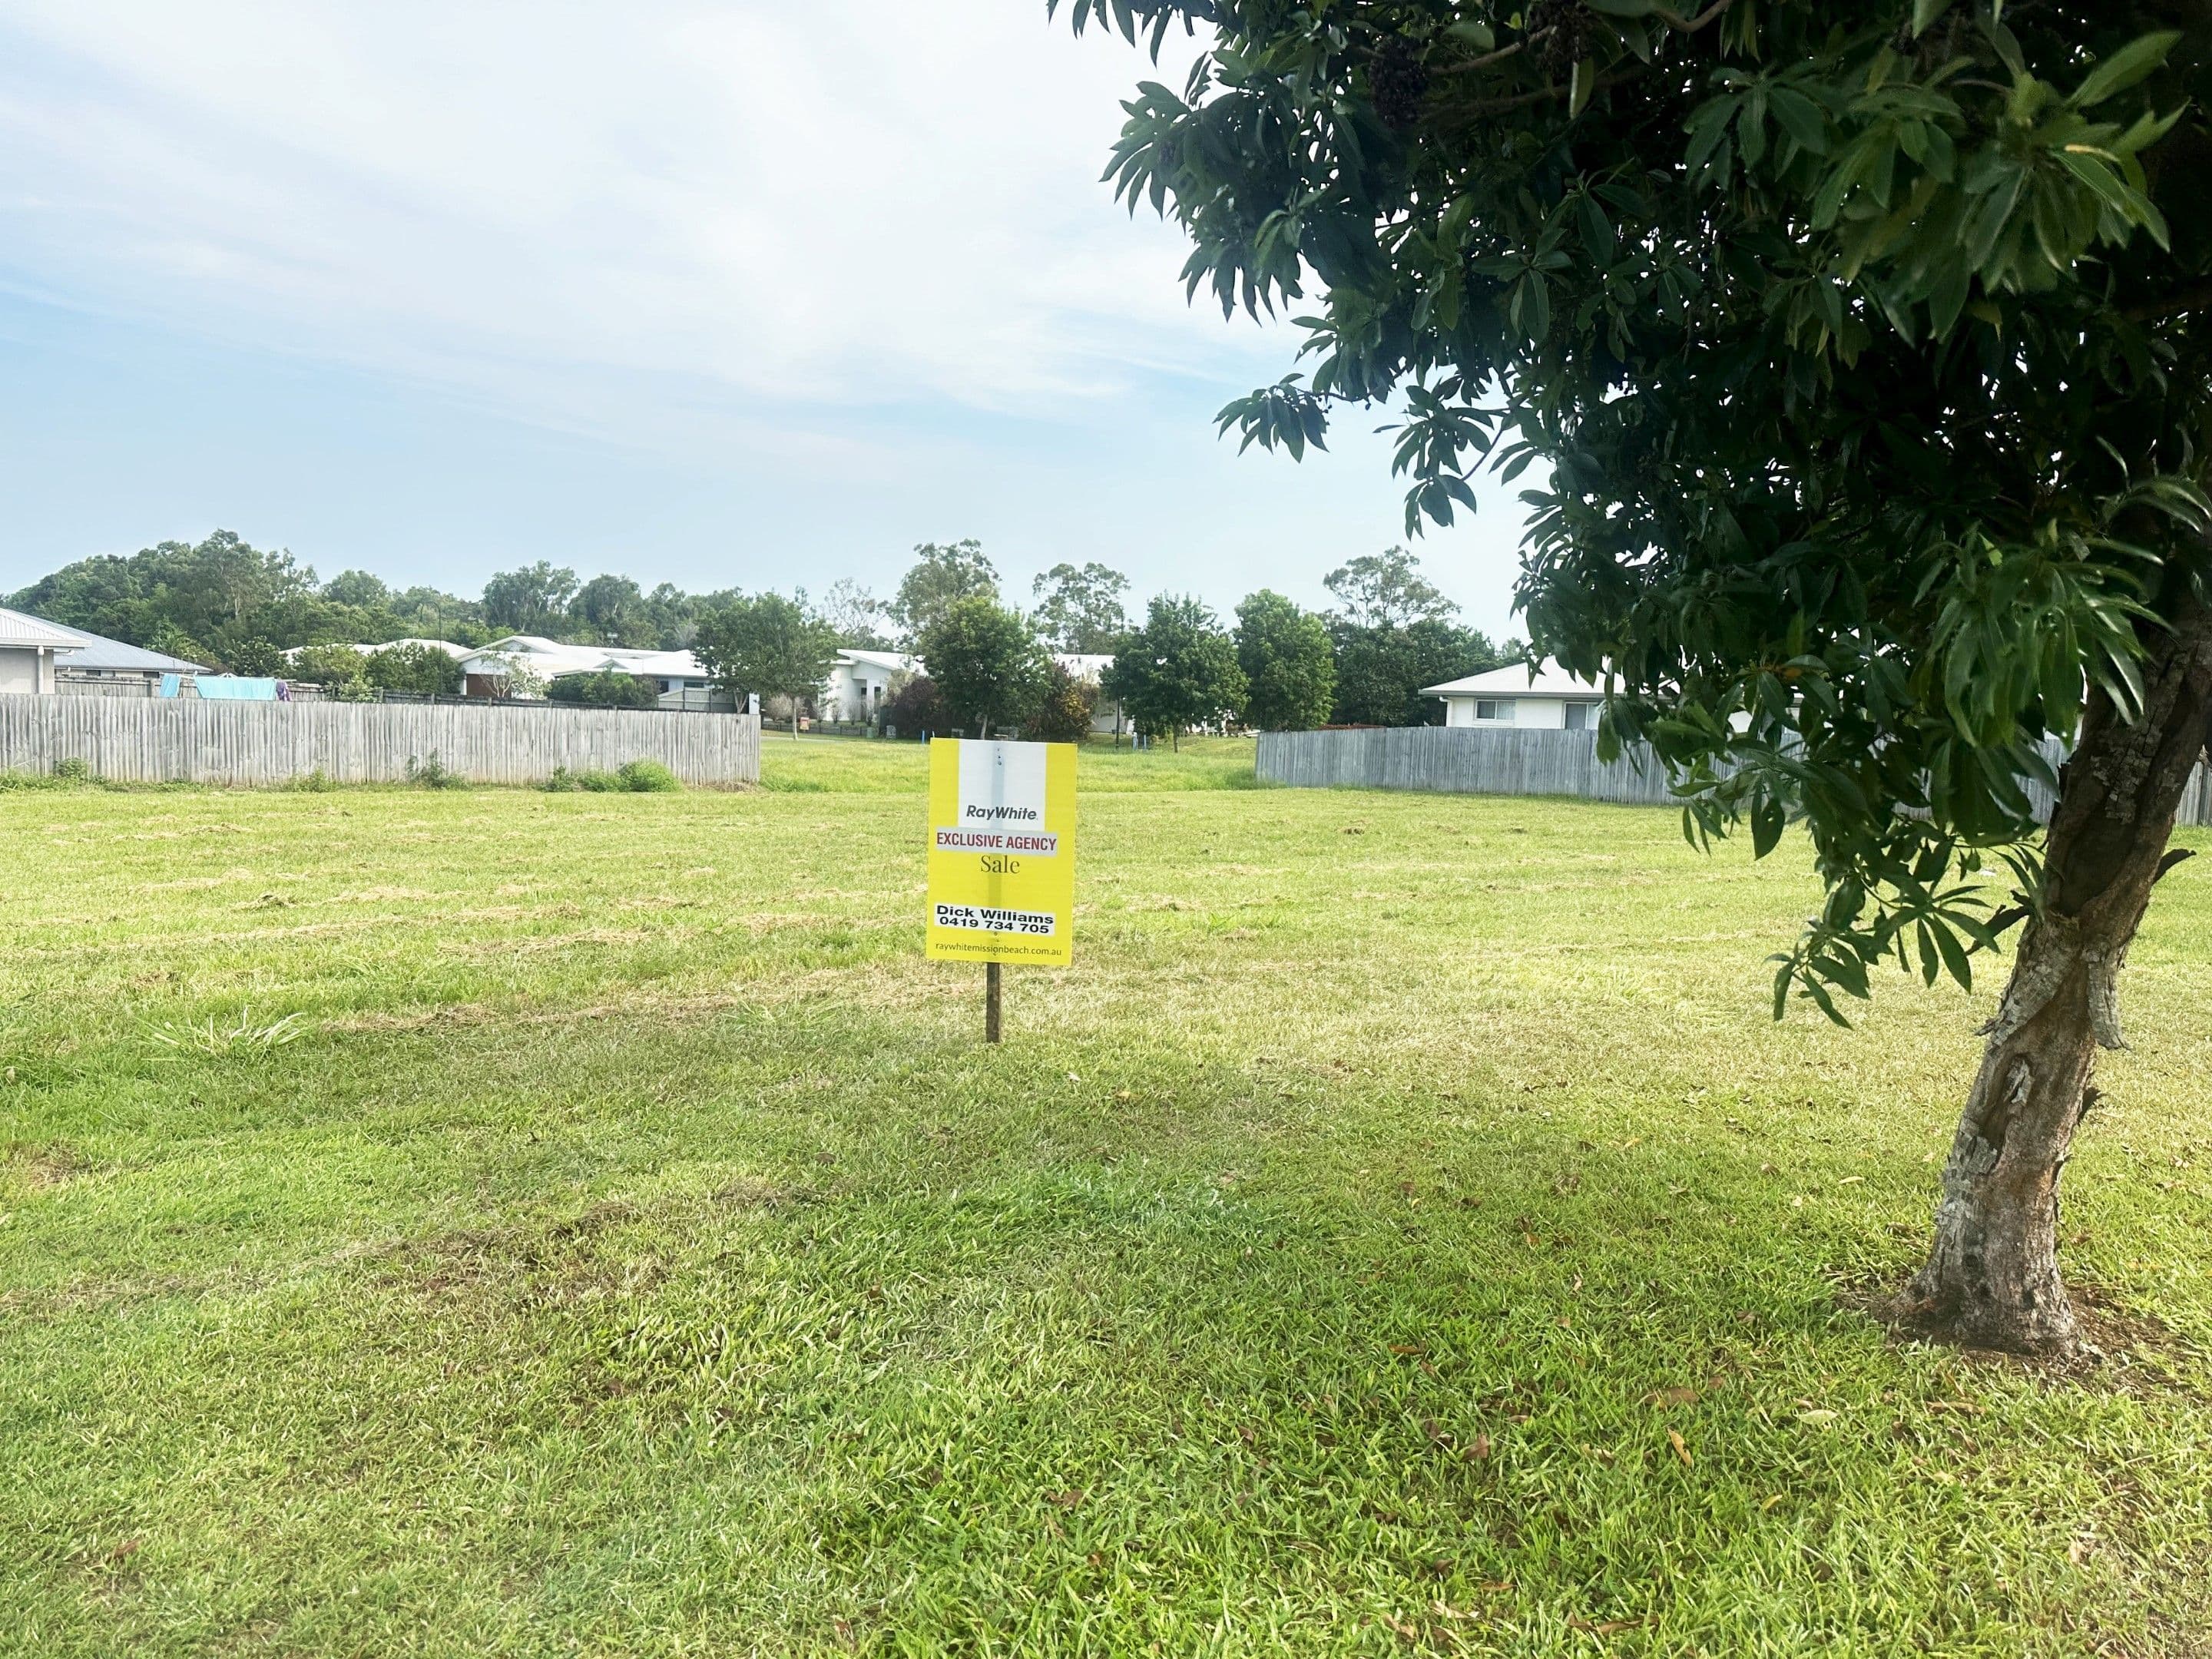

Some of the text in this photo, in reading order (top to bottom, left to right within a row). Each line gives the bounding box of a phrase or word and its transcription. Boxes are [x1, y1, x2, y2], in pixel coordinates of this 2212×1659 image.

[937, 832, 1057, 851] EXCLUSIVE AGENCY
[980, 855, 1020, 873] Sale
[936, 905, 1054, 924] Dick Williams
[939, 916, 1049, 934] 0419 734 705
[935, 942, 1062, 956] raywhitemissionbeach.com.au
